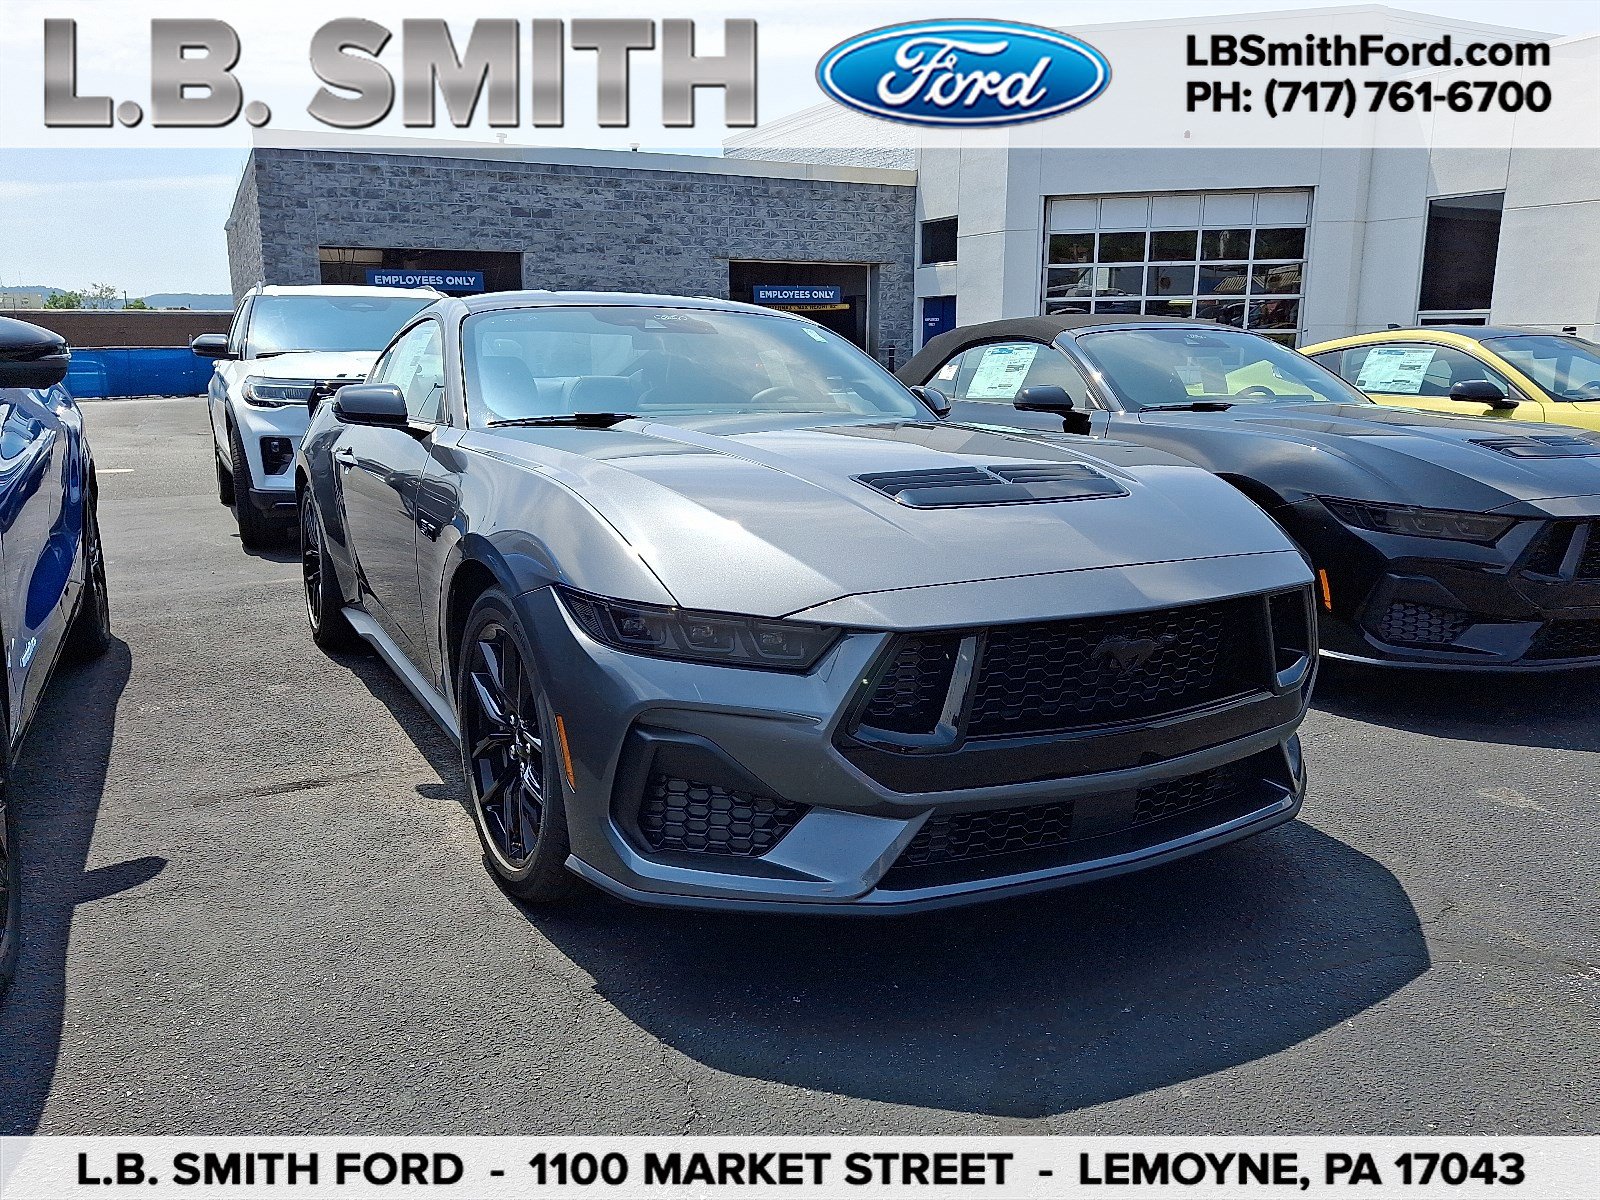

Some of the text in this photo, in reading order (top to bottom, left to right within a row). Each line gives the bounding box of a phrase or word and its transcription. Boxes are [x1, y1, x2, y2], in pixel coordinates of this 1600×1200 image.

[374, 275, 476, 286] EMPLOYEES ONLY
[759, 290, 835, 299] EMPLOYEES ONLY
